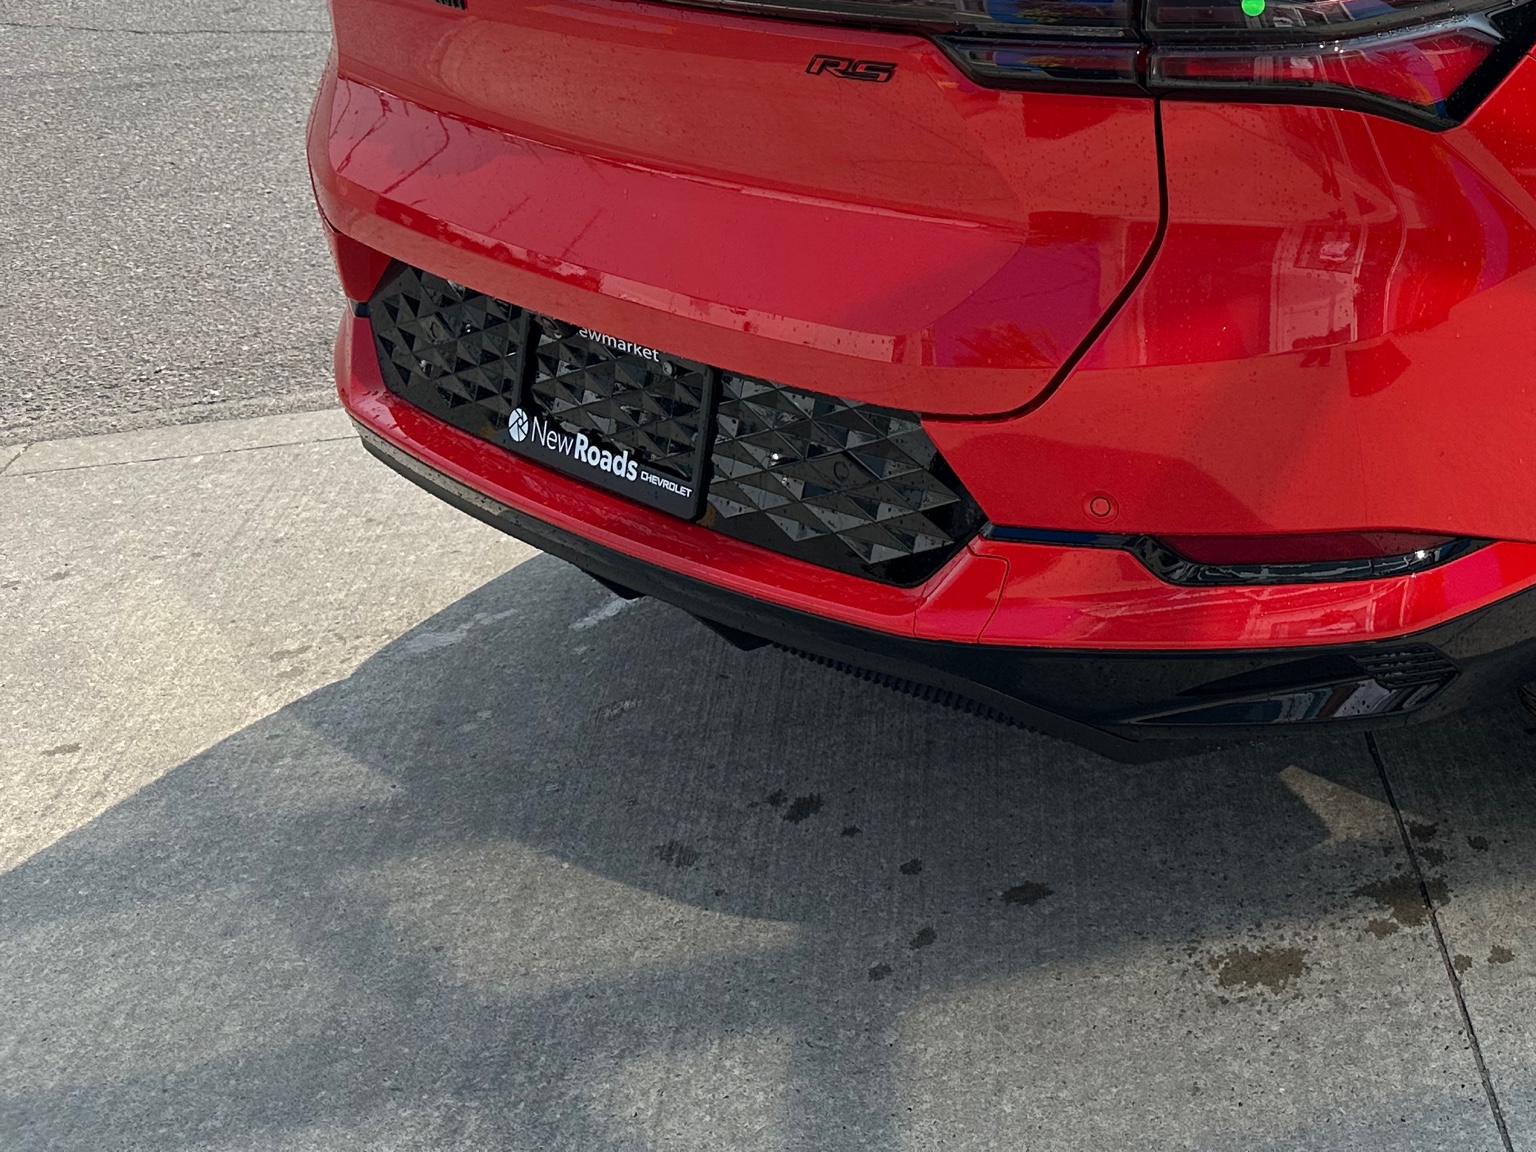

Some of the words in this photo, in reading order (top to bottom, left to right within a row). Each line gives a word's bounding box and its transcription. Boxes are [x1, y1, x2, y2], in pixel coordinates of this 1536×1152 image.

[805, 54, 898, 83] RS
[577, 328, 660, 362] ewmarket
[640, 470, 692, 498] CHEVROLET
